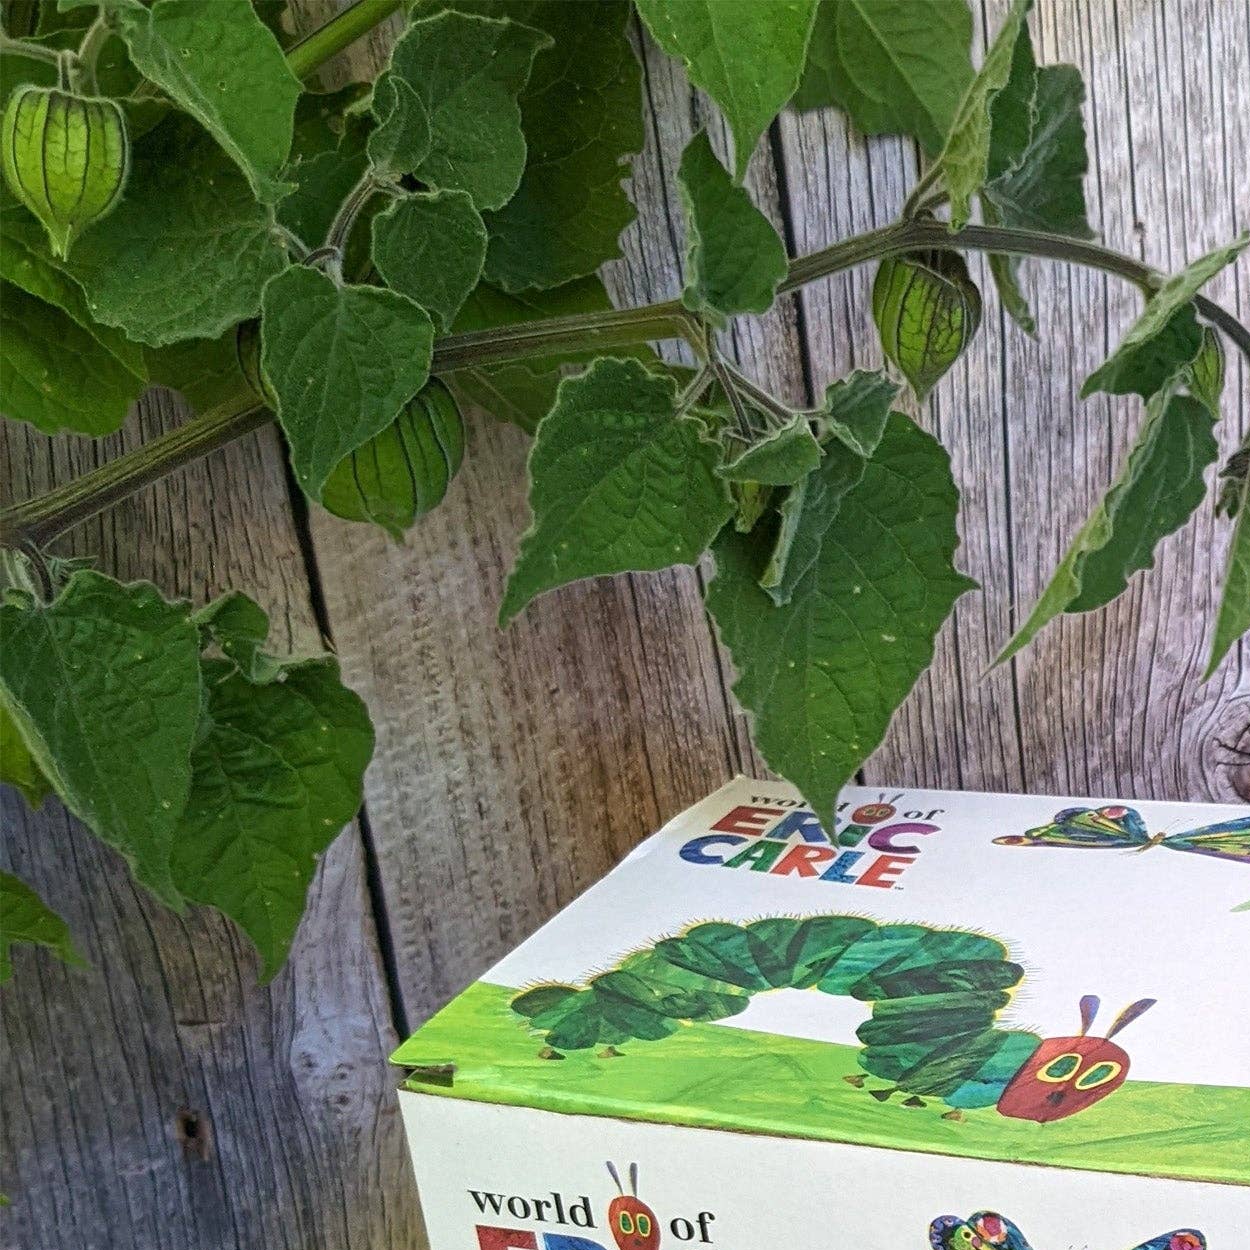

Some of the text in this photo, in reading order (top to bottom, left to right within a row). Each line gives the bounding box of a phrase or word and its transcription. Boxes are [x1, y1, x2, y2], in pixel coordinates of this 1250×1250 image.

[710, 804, 941, 854] ERIC
[903, 808, 945, 821] of
[467, 1190, 716, 1244] world of
